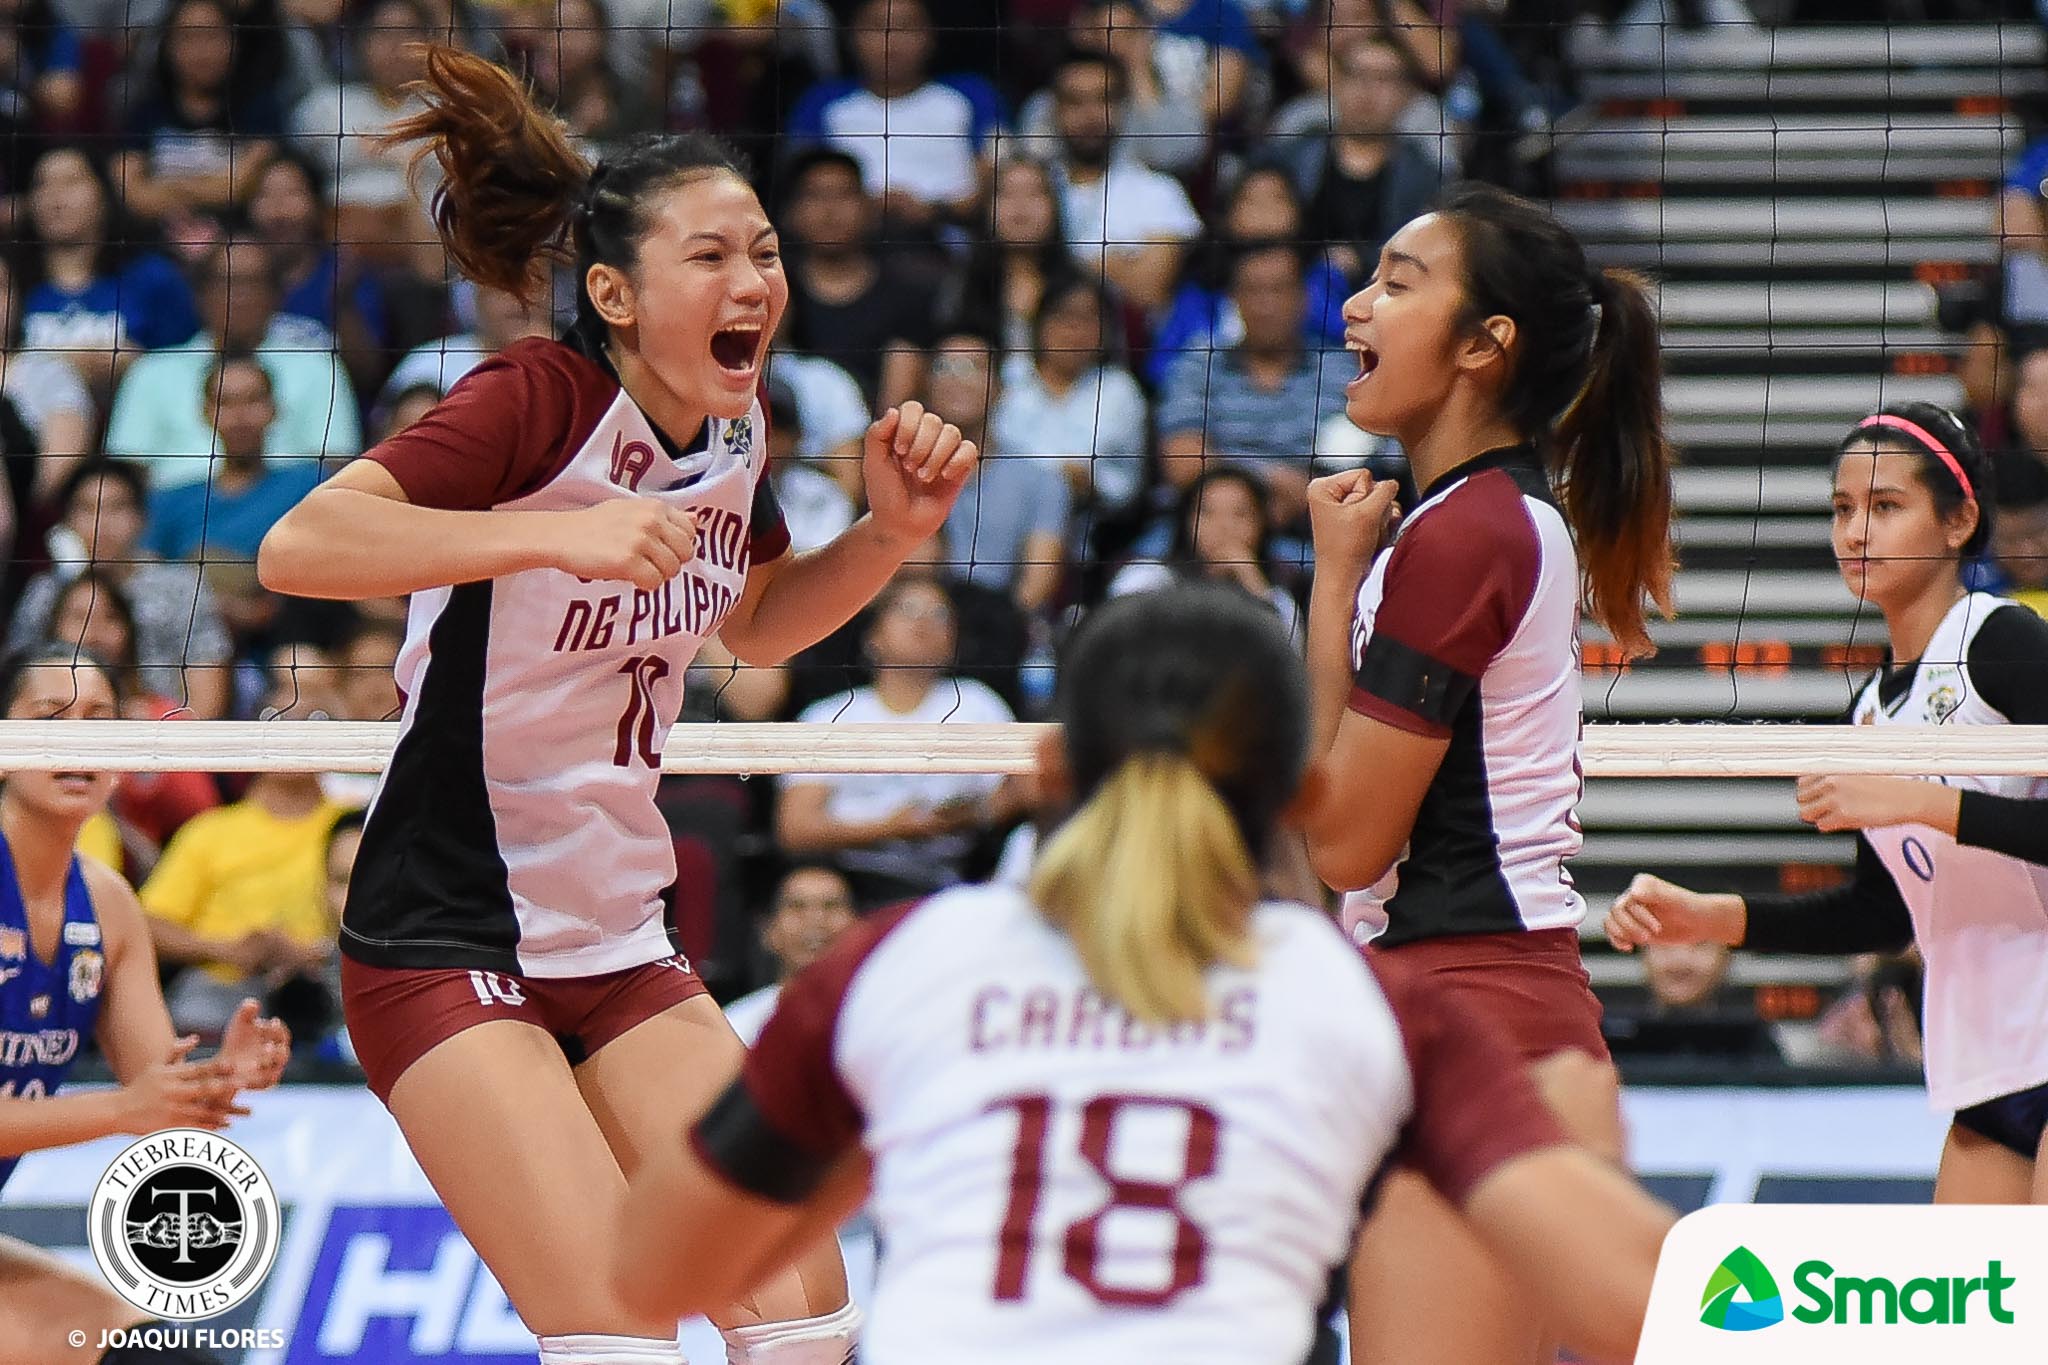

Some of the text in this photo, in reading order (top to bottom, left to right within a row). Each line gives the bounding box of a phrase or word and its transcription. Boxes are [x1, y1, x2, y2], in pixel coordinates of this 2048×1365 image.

[553, 570, 741, 652] NG PILIPIN
[981, 1093, 1223, 1307] 18
